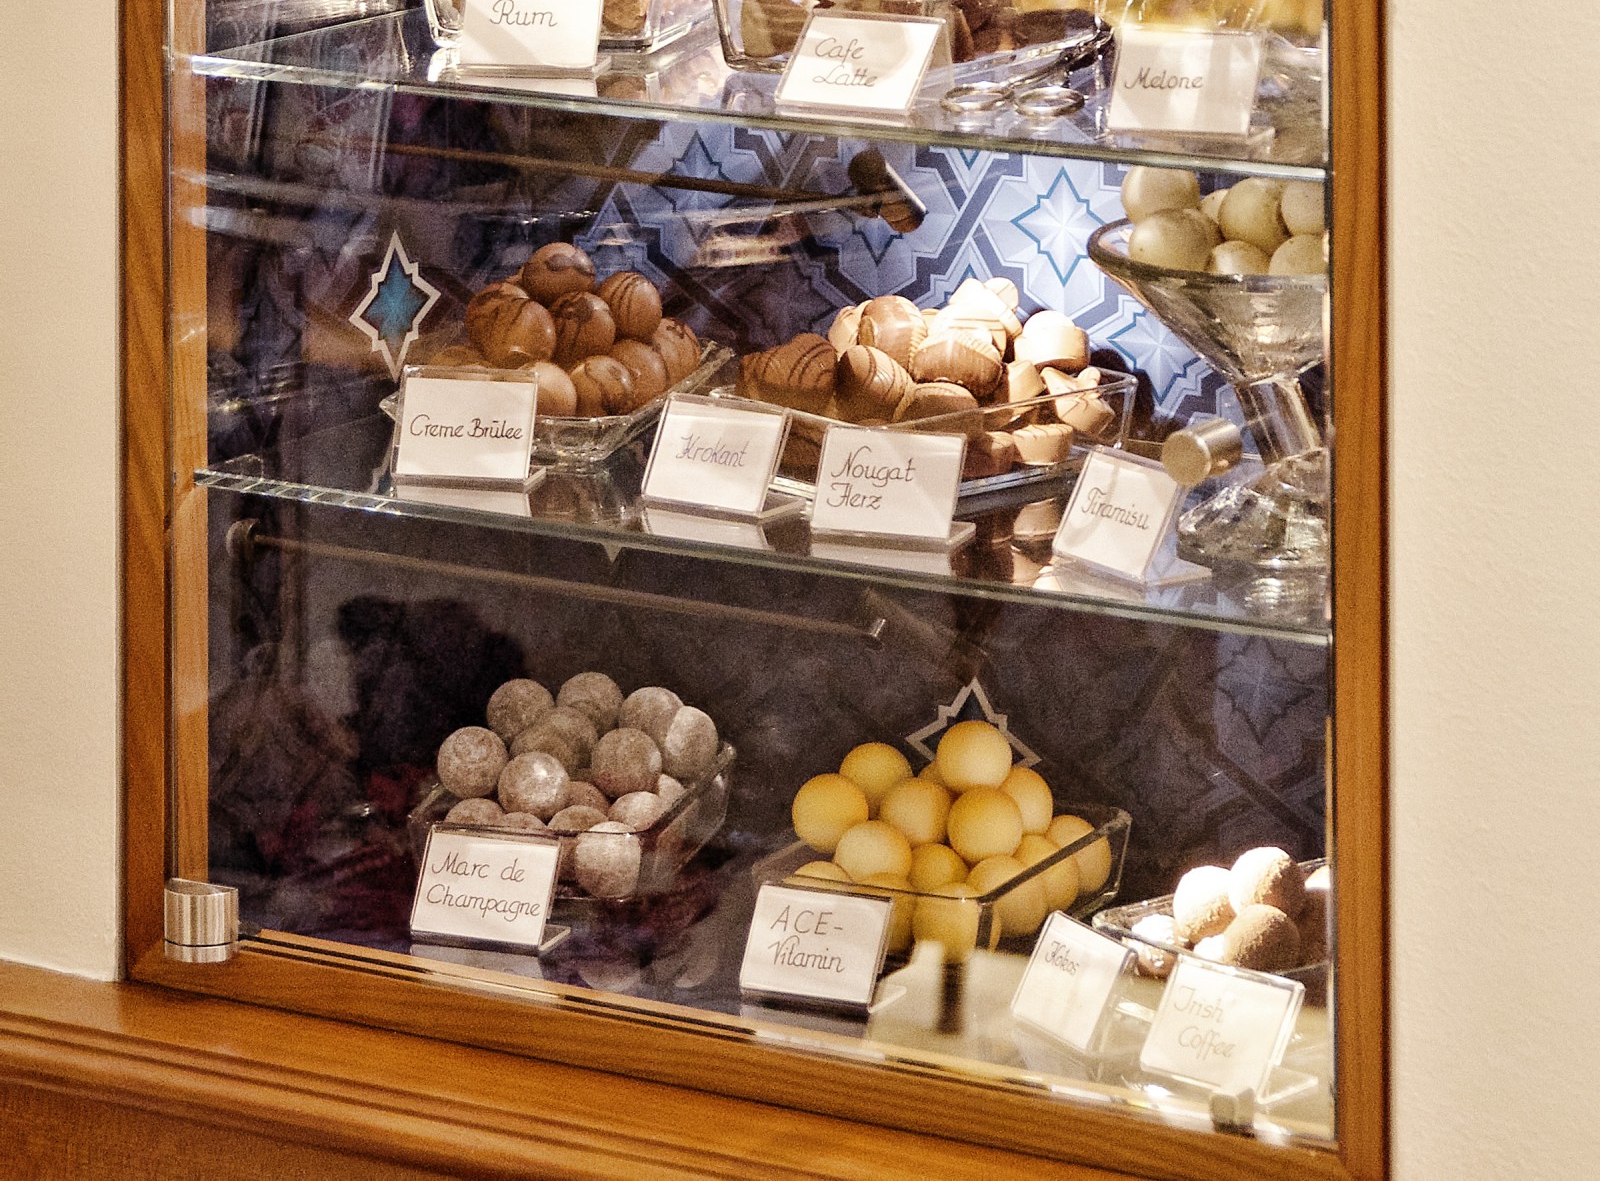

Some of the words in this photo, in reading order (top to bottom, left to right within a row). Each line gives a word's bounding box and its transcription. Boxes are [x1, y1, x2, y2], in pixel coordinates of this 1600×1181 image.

[814, 37, 865, 65] Cafe
[812, 64, 878, 87] Latte
[1124, 67, 1204, 90] Melone
[410, 414, 464, 438] Creme
[831, 445, 916, 488] Nougat
[826, 482, 883, 510] Herz
[1081, 487, 1150, 531] Tiramisu
[431, 851, 490, 879] Marc
[500, 857, 526, 883] de
[426, 883, 541, 923] Champagne
[770, 904, 843, 935] ACE-
[768, 935, 846, 973] Vitamin
[1174, 985, 1224, 1024] Irish
[1178, 1026, 1236, 1061] Coffee
